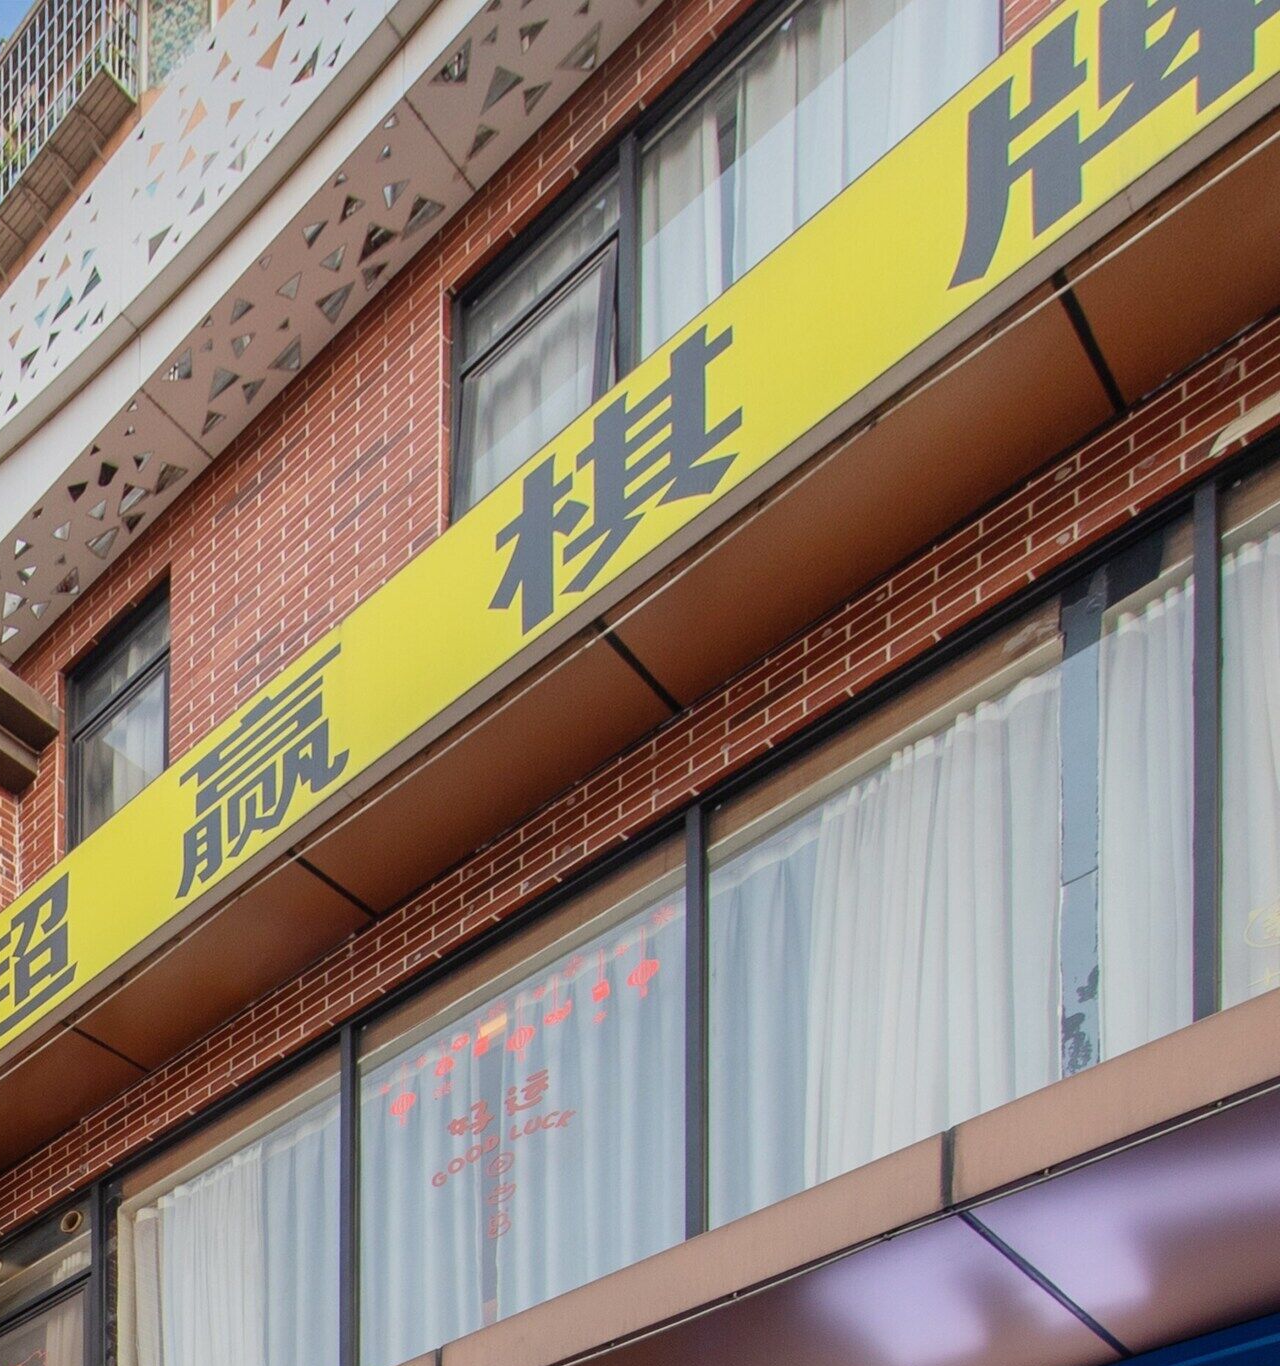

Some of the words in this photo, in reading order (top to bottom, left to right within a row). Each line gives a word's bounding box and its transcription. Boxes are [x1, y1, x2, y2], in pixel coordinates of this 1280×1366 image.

[448, 1069, 549, 1136] 好运
[432, 1135, 500, 1188] GOOD
[509, 1110, 576, 1141] LUCK
